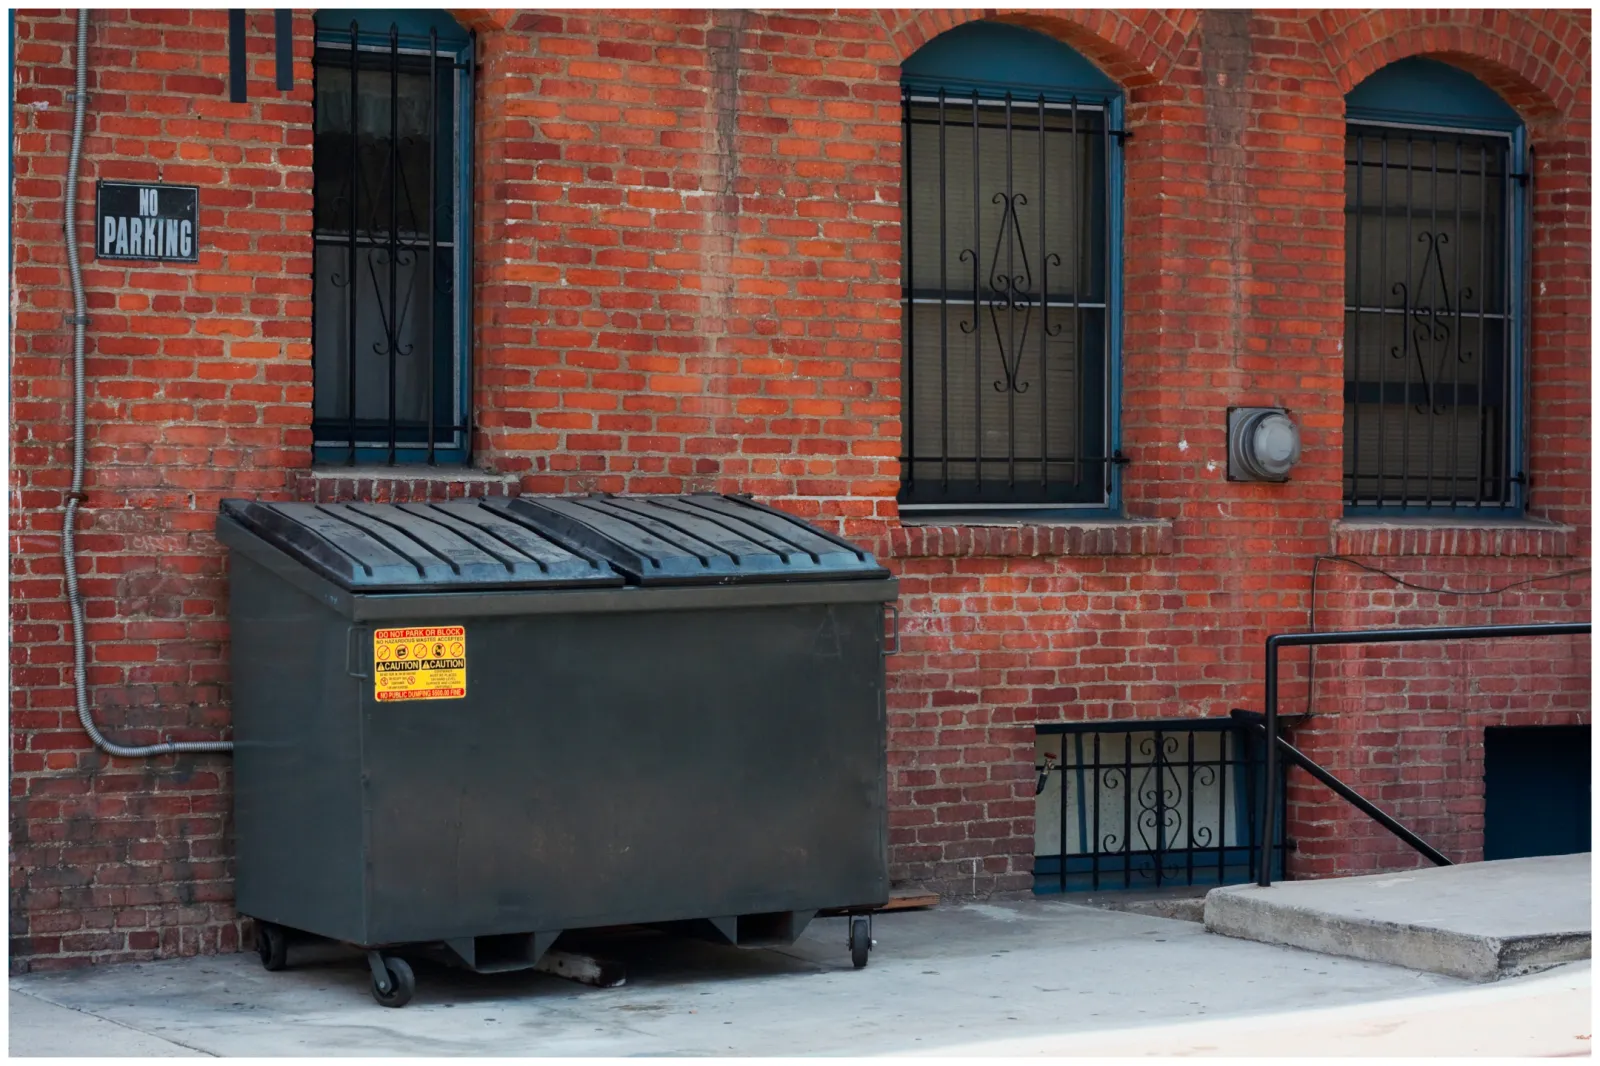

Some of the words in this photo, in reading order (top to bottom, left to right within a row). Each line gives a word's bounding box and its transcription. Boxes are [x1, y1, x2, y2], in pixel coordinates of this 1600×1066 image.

[139, 188, 158, 217] NO
[104, 216, 192, 257] PARKING
[390, 630, 404, 638] NOT
[405, 629, 425, 637] PARK
[437, 628, 461, 636] BLOCK
[384, 661, 419, 671] CAUTION
[429, 659, 464, 669] CAUTION
[380, 691, 389, 699] NO
[389, 690, 408, 699] PUBLIC
[408, 689, 432, 698] DUMPING
[451, 688, 461, 697] FINE
